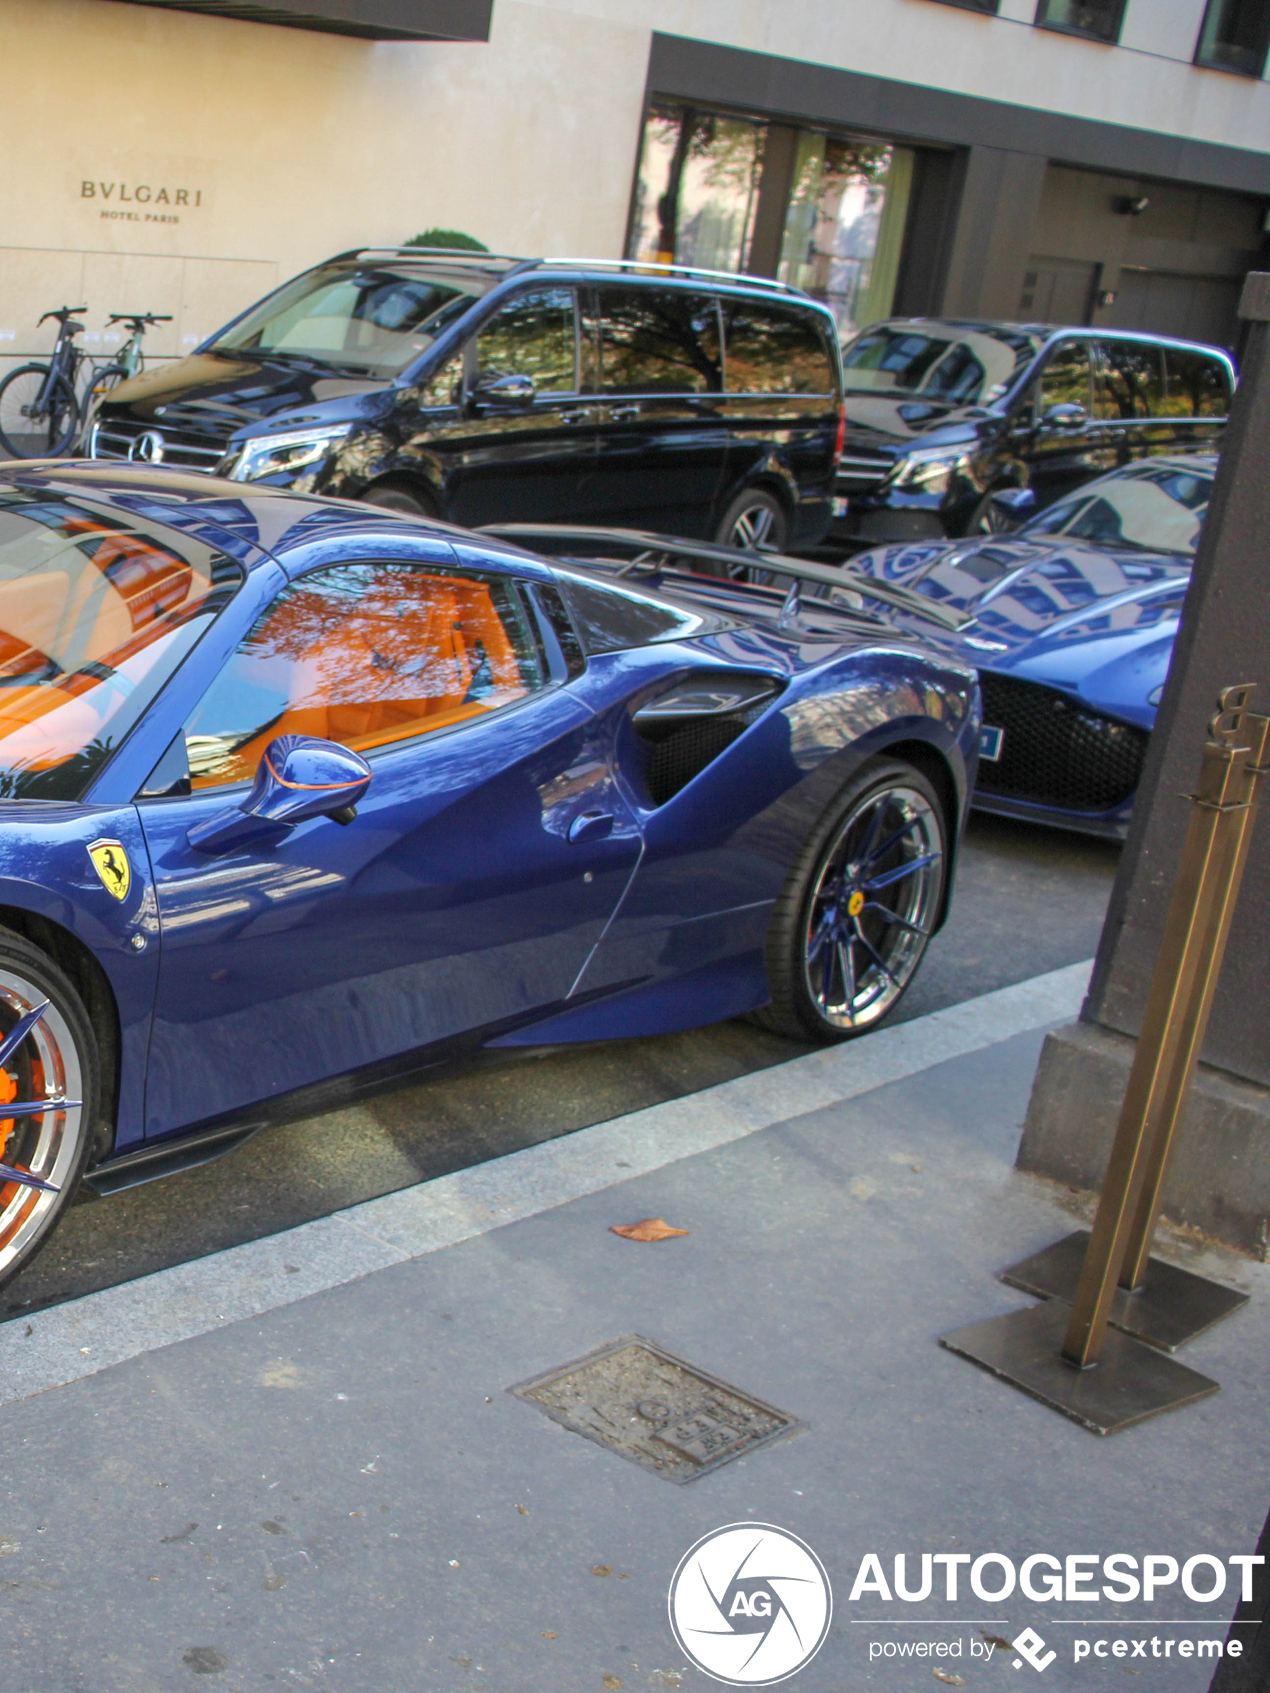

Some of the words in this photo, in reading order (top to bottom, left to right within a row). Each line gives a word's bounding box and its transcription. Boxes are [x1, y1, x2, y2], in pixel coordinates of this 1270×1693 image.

[81, 180, 202, 207] BVLGARI
[100, 210, 140, 222] HOTEL
[145, 213, 180, 224] PARIS
